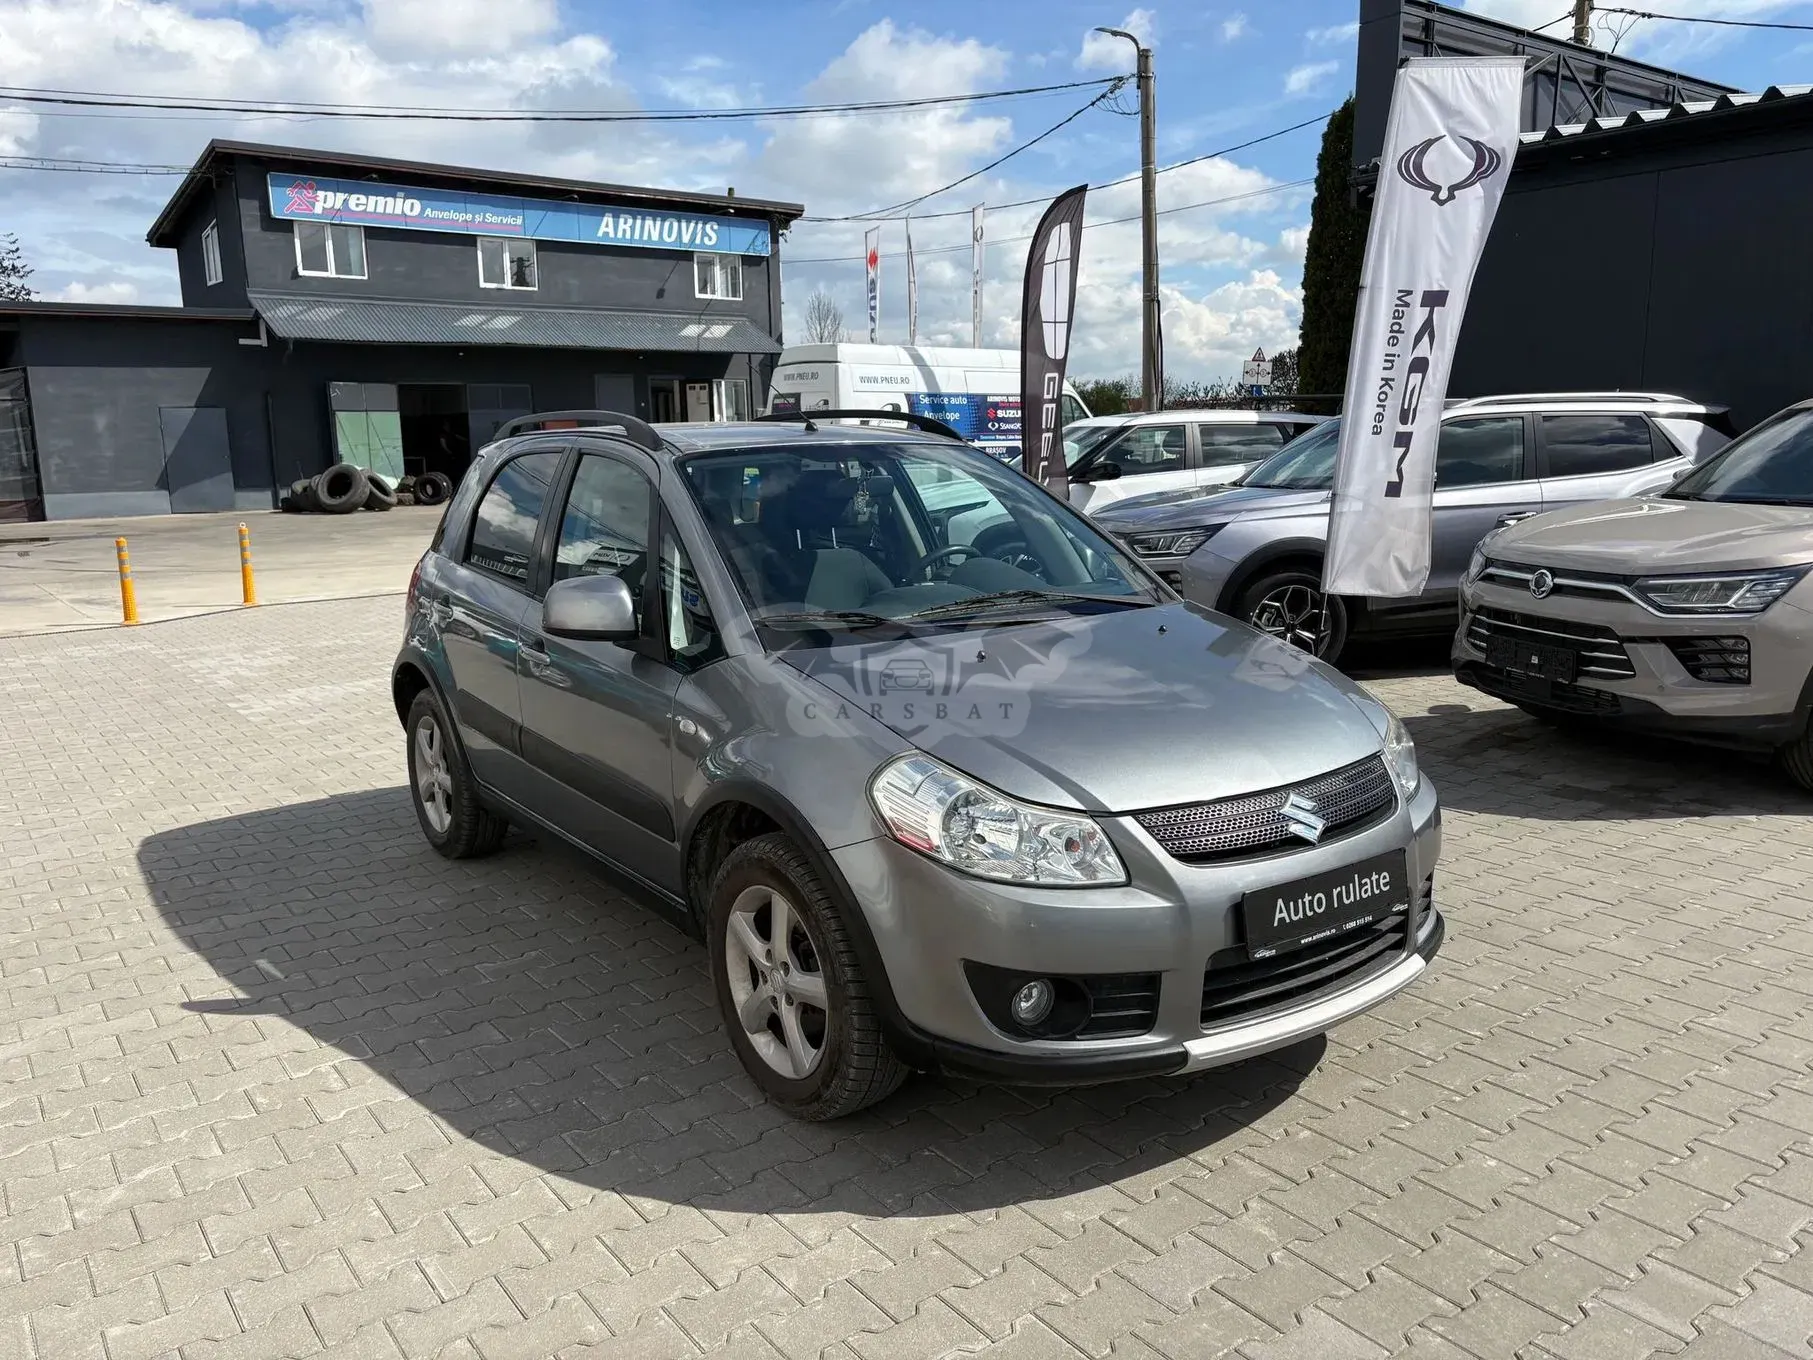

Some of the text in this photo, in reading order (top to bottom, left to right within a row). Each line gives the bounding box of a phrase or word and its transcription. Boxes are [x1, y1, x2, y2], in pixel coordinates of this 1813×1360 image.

[314, 190, 421, 217] premio
[424, 207, 472, 222] Anvelope
[485, 213, 522, 225] Servicii
[597, 212, 719, 246] ARINOVIS
[1371, 289, 1414, 435] Made in Korea
[783, 371, 819, 381] WWW.PNEU.RO
[859, 376, 910, 385] WWW.PNEU.RO
[920, 394, 967, 404] Service auto
[1384, 290, 1450, 498] KGM
[923, 410, 960, 421] Anvelope
[1273, 871, 1390, 927] Auto rulate
